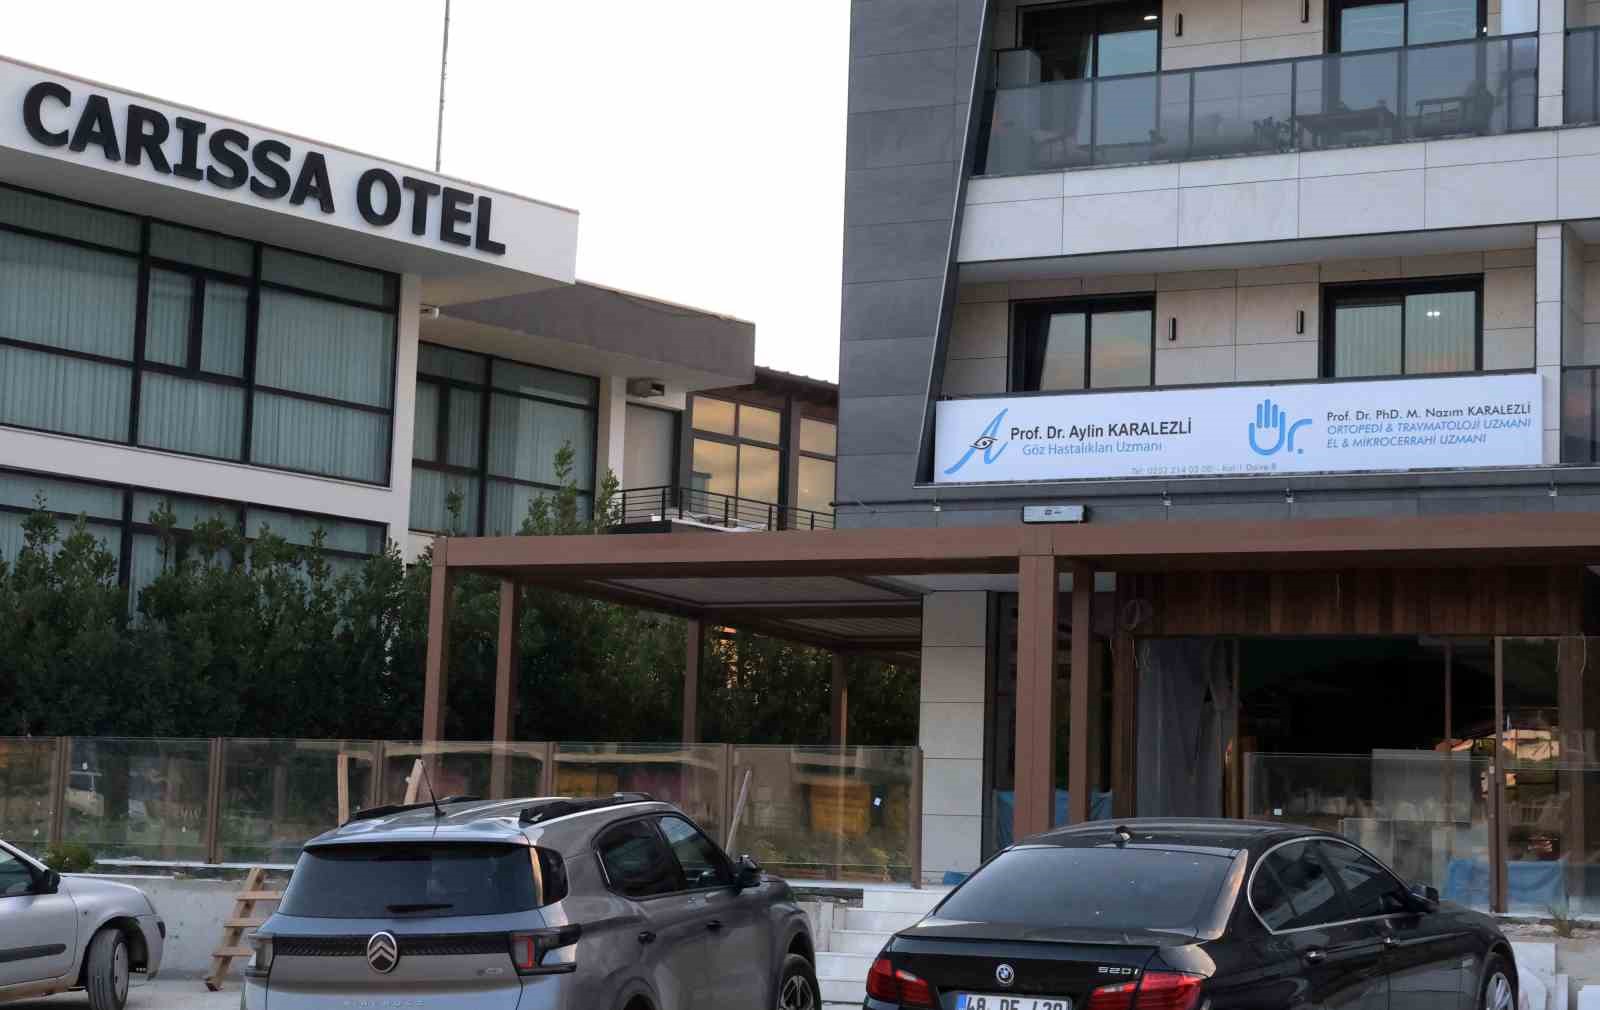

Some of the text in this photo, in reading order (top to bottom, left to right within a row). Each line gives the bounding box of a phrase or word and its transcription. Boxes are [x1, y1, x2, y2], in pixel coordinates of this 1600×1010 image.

[22, 81, 506, 256] CARISSA OTEL
[1327, 410, 1352, 421] Prof.
[1356, 410, 1371, 421] Dr.
[1376, 408, 1402, 419] PhD.
[1407, 408, 1420, 418] M.
[1467, 401, 1531, 416] KARALEZLİ
[1010, 416, 1192, 441] Prof. Dr. Aylin KARALEZLİ
[1386, 423, 1393, 433] &
[1484, 418, 1531, 429] UZMANI
[1327, 438, 1338, 449] EL
[1342, 438, 1349, 448] &
[1440, 433, 1486, 445] UZMANI
